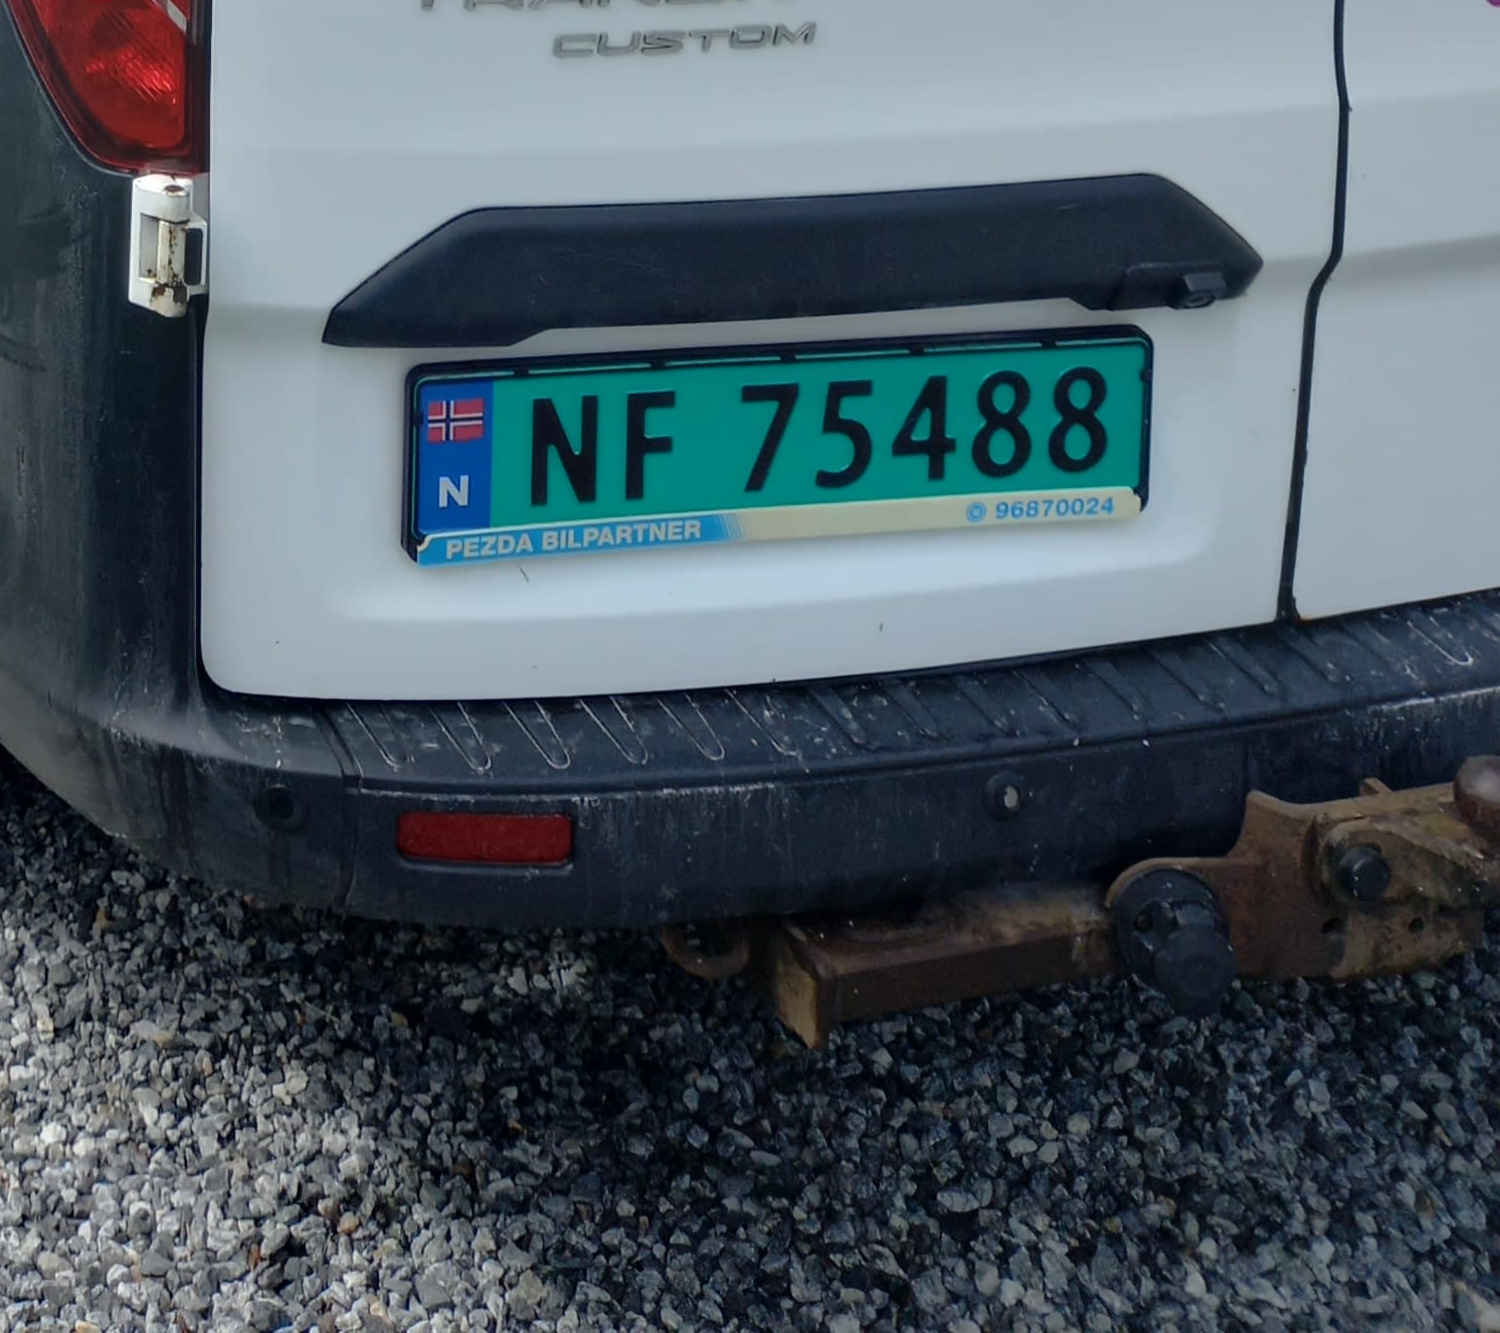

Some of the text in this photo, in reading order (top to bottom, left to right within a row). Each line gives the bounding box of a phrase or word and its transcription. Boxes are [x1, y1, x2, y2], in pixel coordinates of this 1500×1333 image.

[552, 22, 816, 58] CUSTOM
[529, 366, 1109, 507] NF 75488
[438, 475, 469, 508] N
[996, 497, 1114, 519] 96870024
[446, 520, 702, 560] PEZDA BILPARTNER
